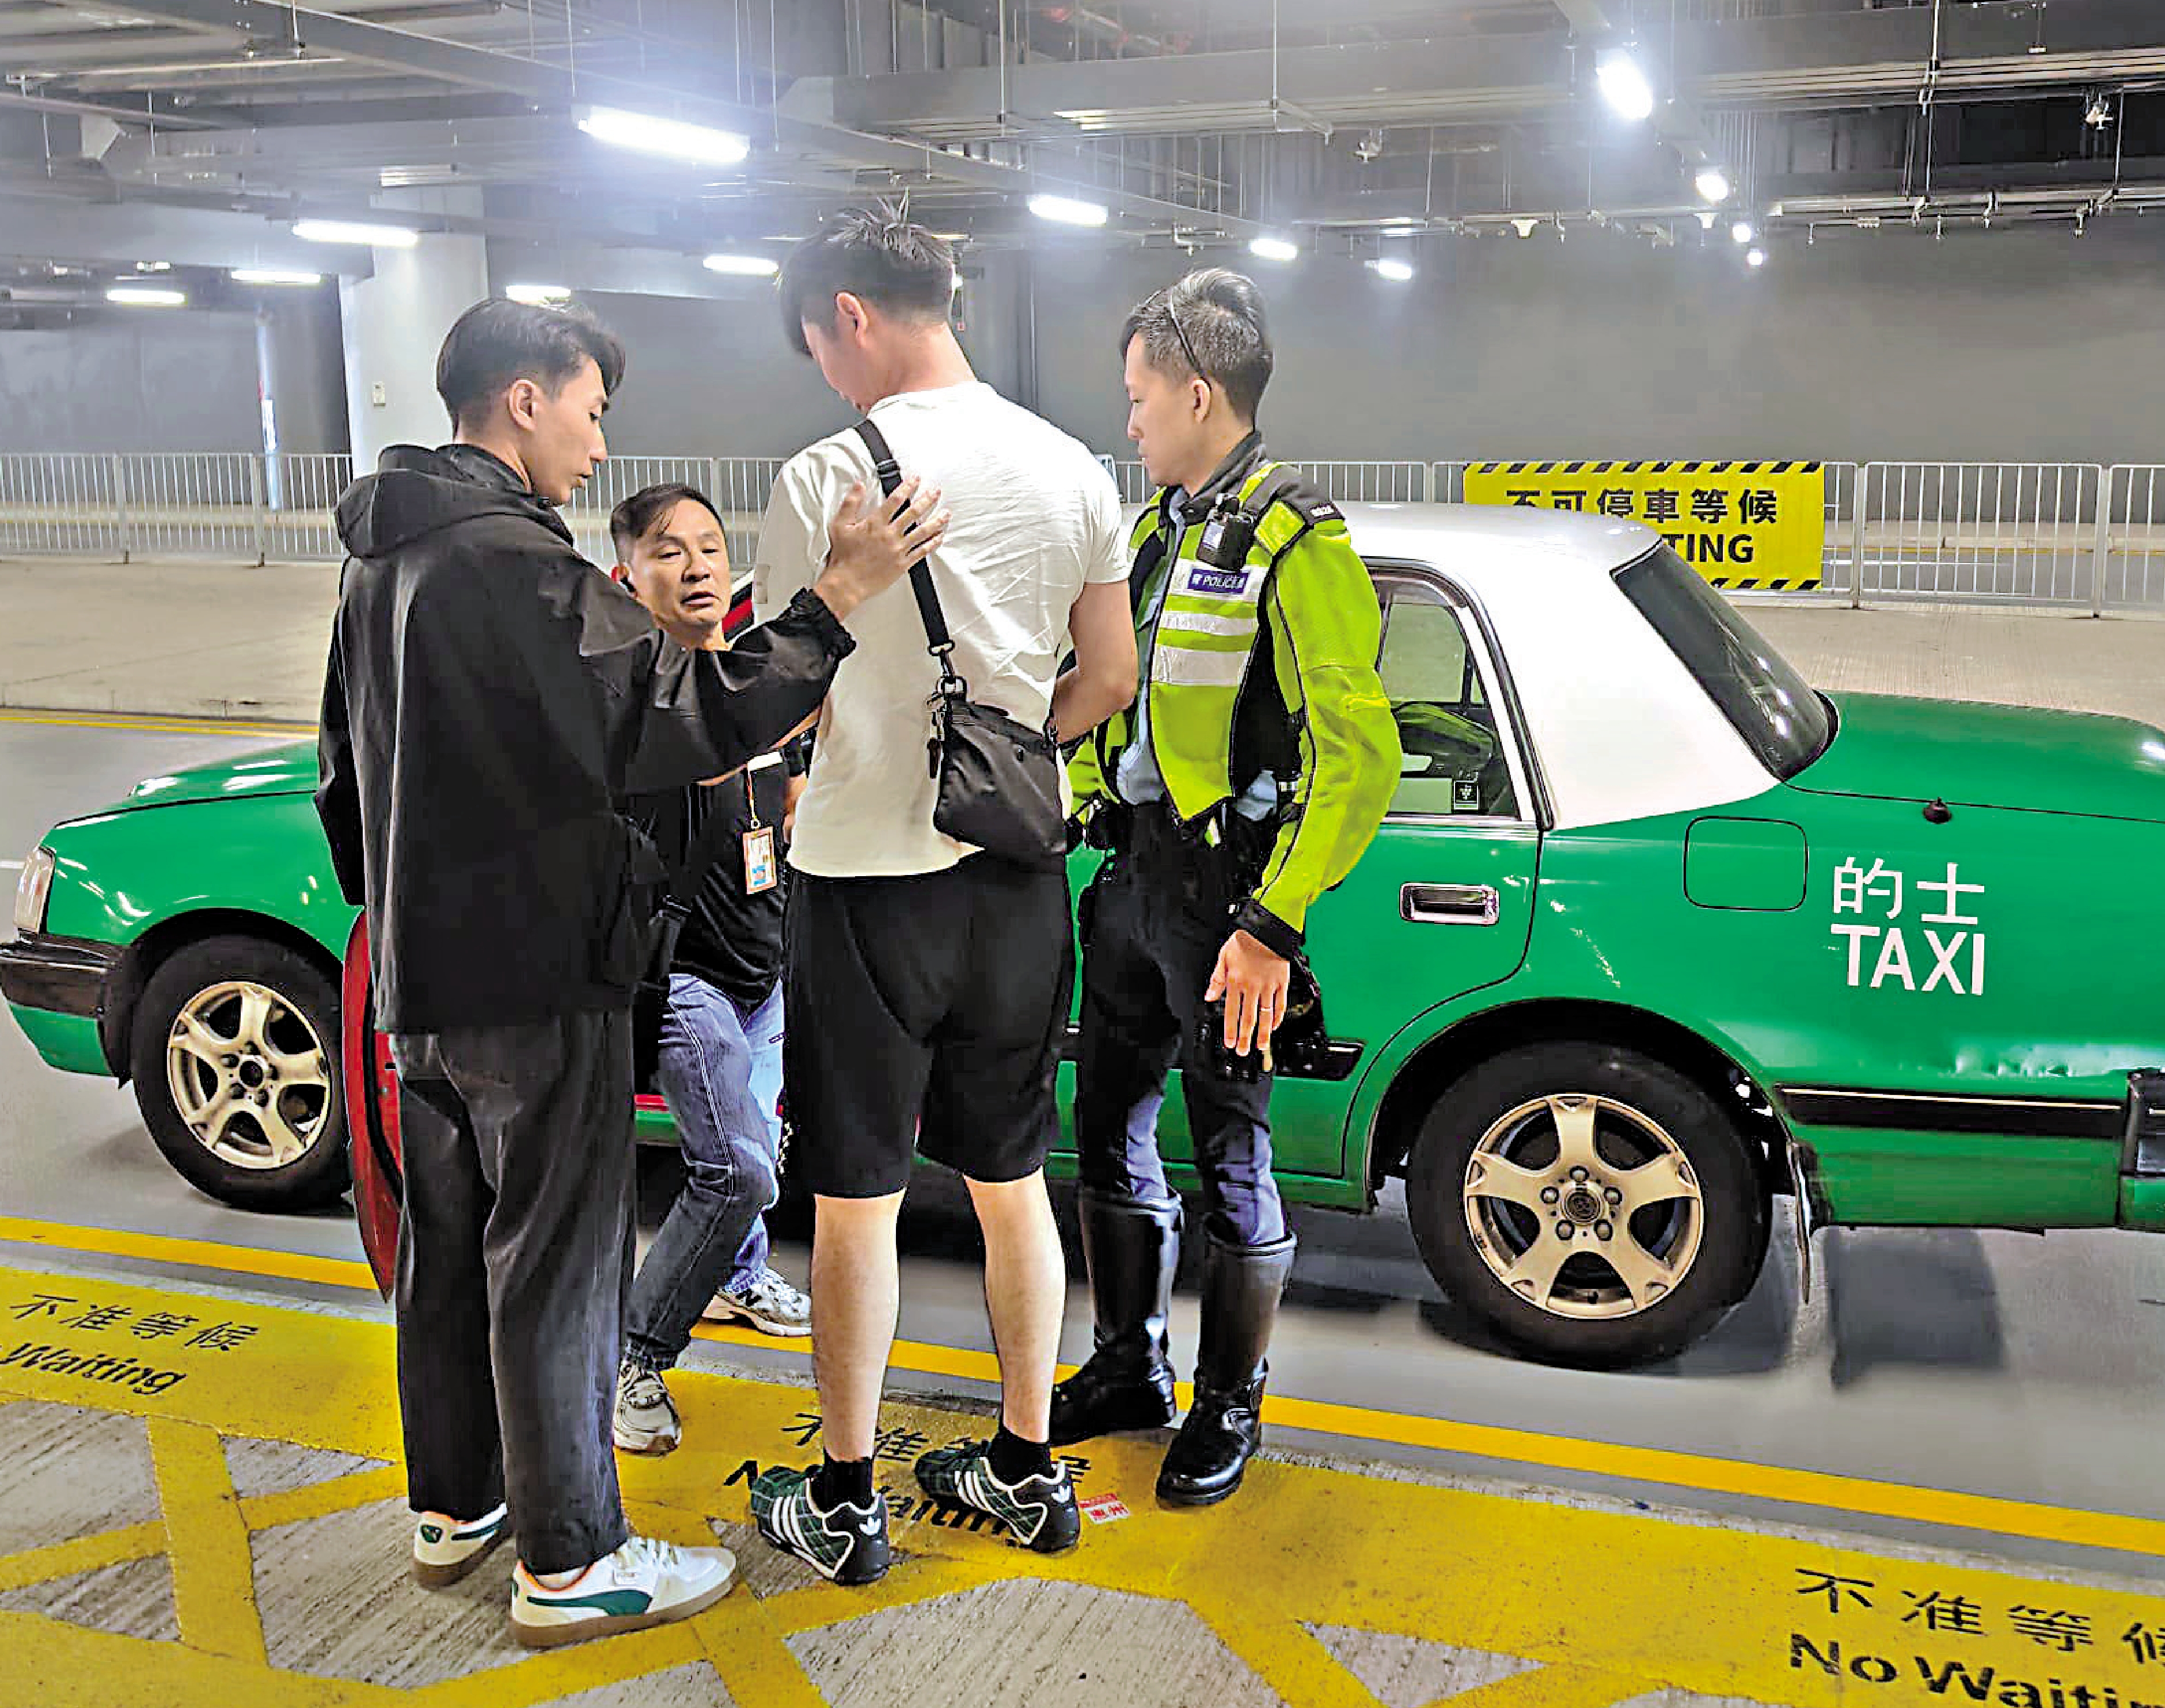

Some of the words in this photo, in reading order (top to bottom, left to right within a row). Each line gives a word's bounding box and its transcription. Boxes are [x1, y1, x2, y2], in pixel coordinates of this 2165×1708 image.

[1661, 533, 1754, 563] TING
[1833, 857, 1985, 925] 的士
[1830, 923, 1985, 996] TAXI
[9, 1294, 260, 1352] 不准等候
[0, 1342, 188, 1395] Waiting
[1790, 1634, 1898, 1683] No
